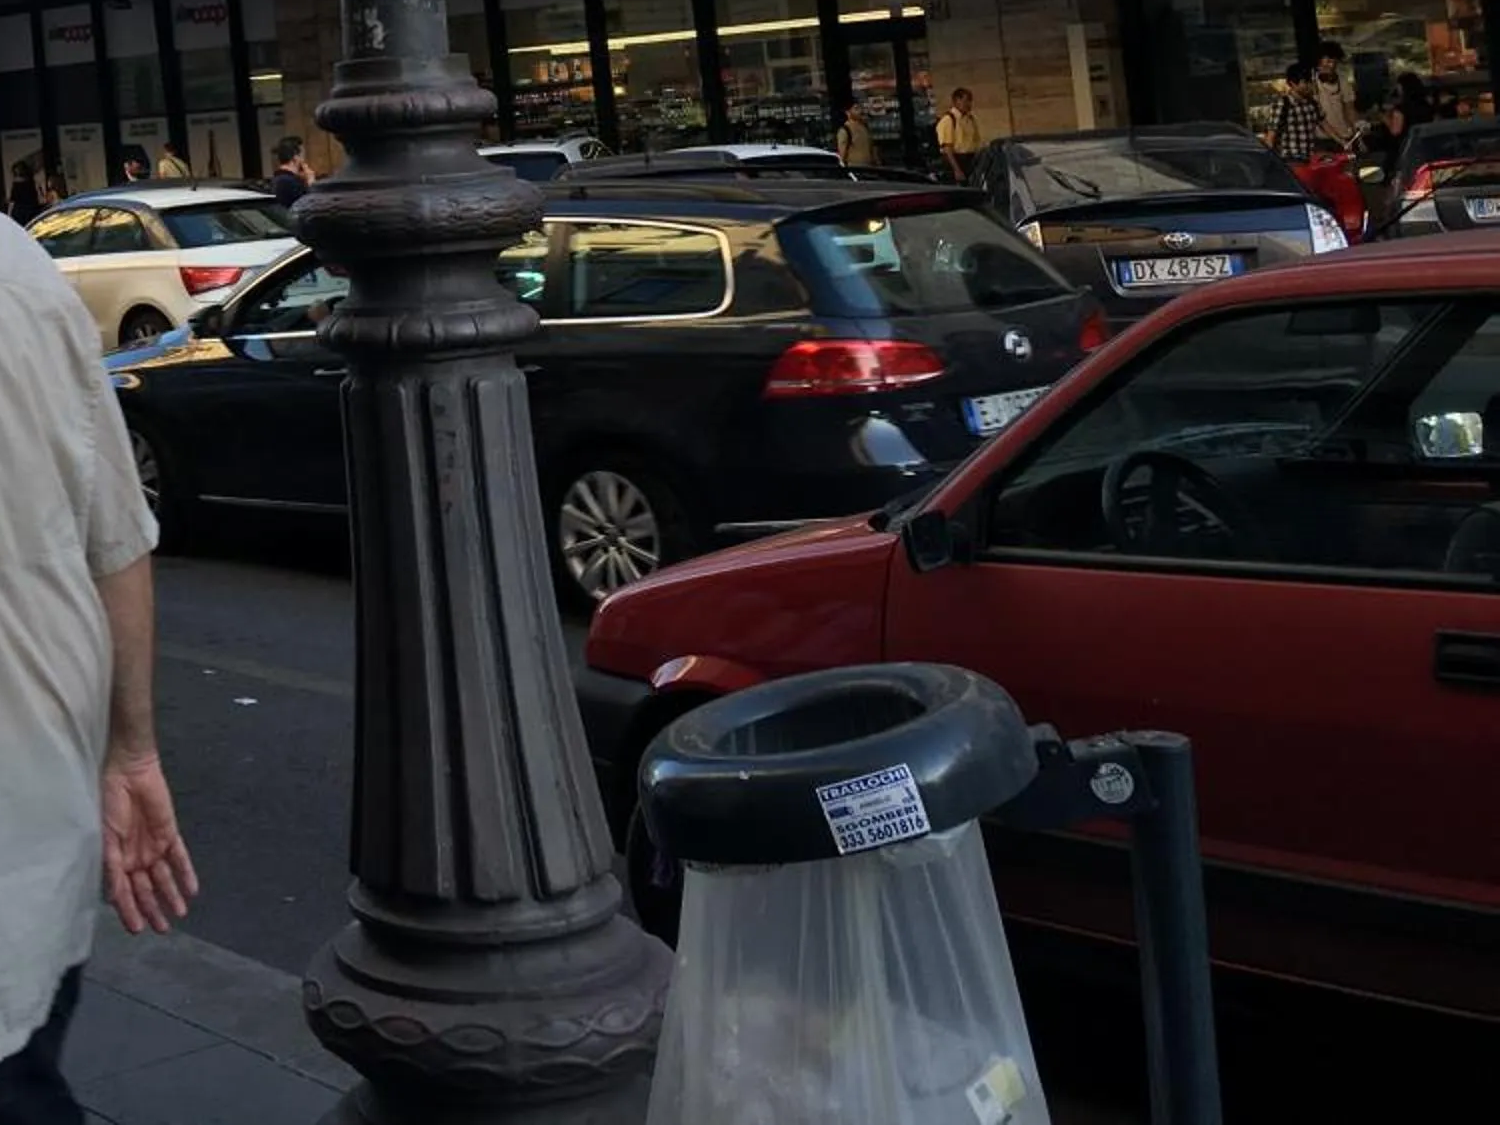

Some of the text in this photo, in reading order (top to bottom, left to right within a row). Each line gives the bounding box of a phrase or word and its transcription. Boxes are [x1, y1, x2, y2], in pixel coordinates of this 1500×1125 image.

[1133, 255, 1230, 282] DX 487SZ
[822, 766, 910, 801] TRASLOCHI
[840, 815, 926, 850] 333 5601816
